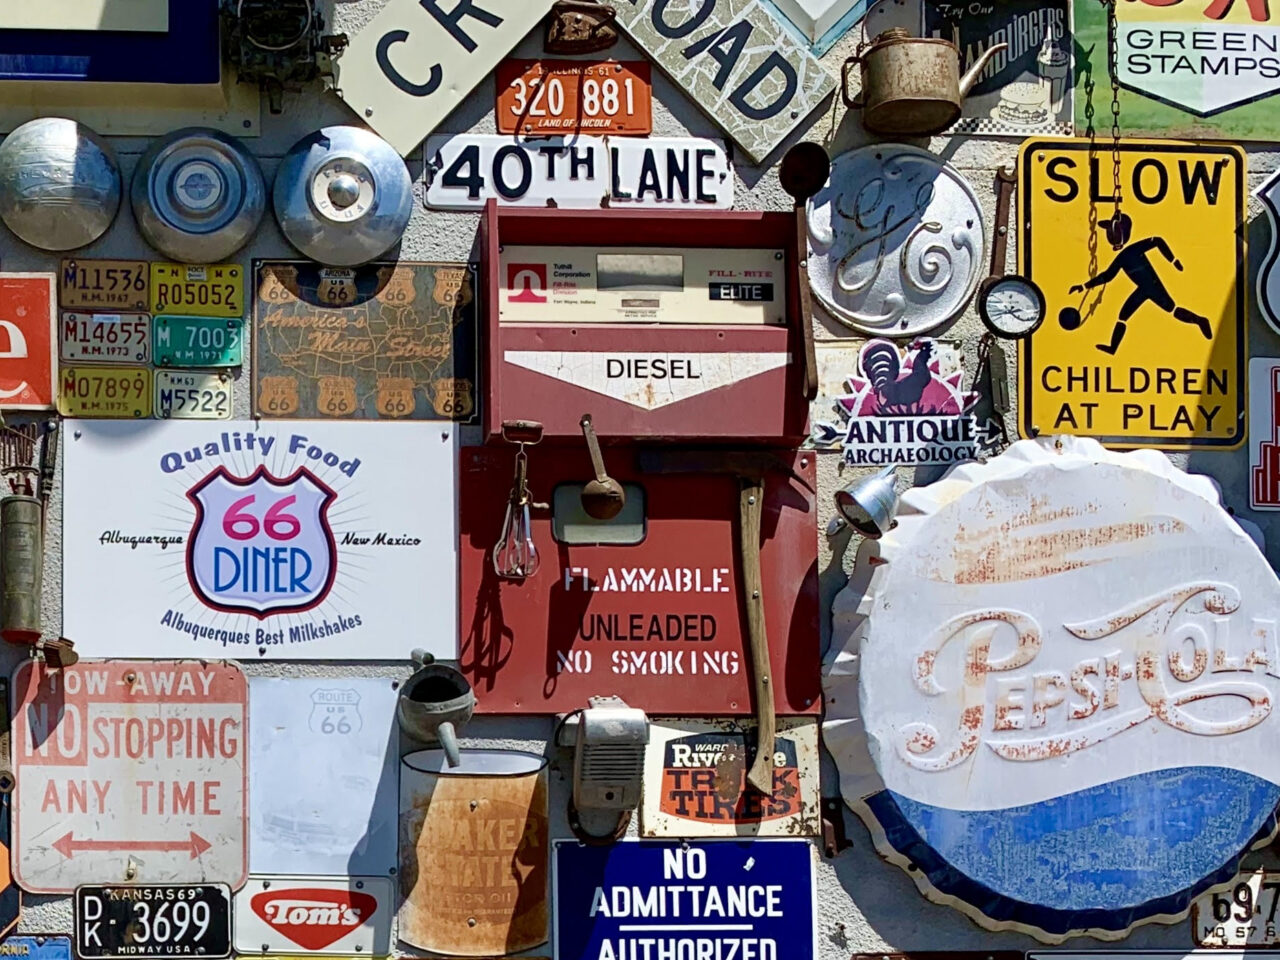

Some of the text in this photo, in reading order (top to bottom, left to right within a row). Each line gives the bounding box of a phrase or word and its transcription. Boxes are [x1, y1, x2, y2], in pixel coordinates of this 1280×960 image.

[1126, 29, 1280, 51] GREEN
[1126, 53, 1280, 79] STAMPS
[509, 78, 634, 117] 320 881
[441, 145, 595, 199] 40TH
[610, 147, 717, 203] LANE
[1043, 155, 1223, 205] SLOW
[719, 284, 764, 300] ELITE
[606, 359, 701, 380] DIESEL
[1040, 366, 1229, 396] CHILDREN
[846, 416, 976, 446] ANTIQUE
[1053, 403, 1221, 432] AT PLAY
[159, 431, 362, 477] Quality Food
[846, 446, 977, 465] ARCHAEOLOGY
[221, 494, 302, 541] 66
[98, 531, 422, 550] Albuquerque New Mexico
[213, 546, 312, 594] DINER
[564, 567, 730, 594] FLAMMABLE
[160, 608, 363, 647] Albuquerques Best Milkshakes
[578, 614, 718, 643] UNLEADED
[556, 650, 739, 676] NO SMOKING
[24, 702, 238, 760] NO STOPPING
[40, 780, 221, 816] ANY TIME
[663, 848, 707, 880] NO
[265, 899, 361, 927] Tom's
[591, 884, 784, 918] ADMITTANCE
